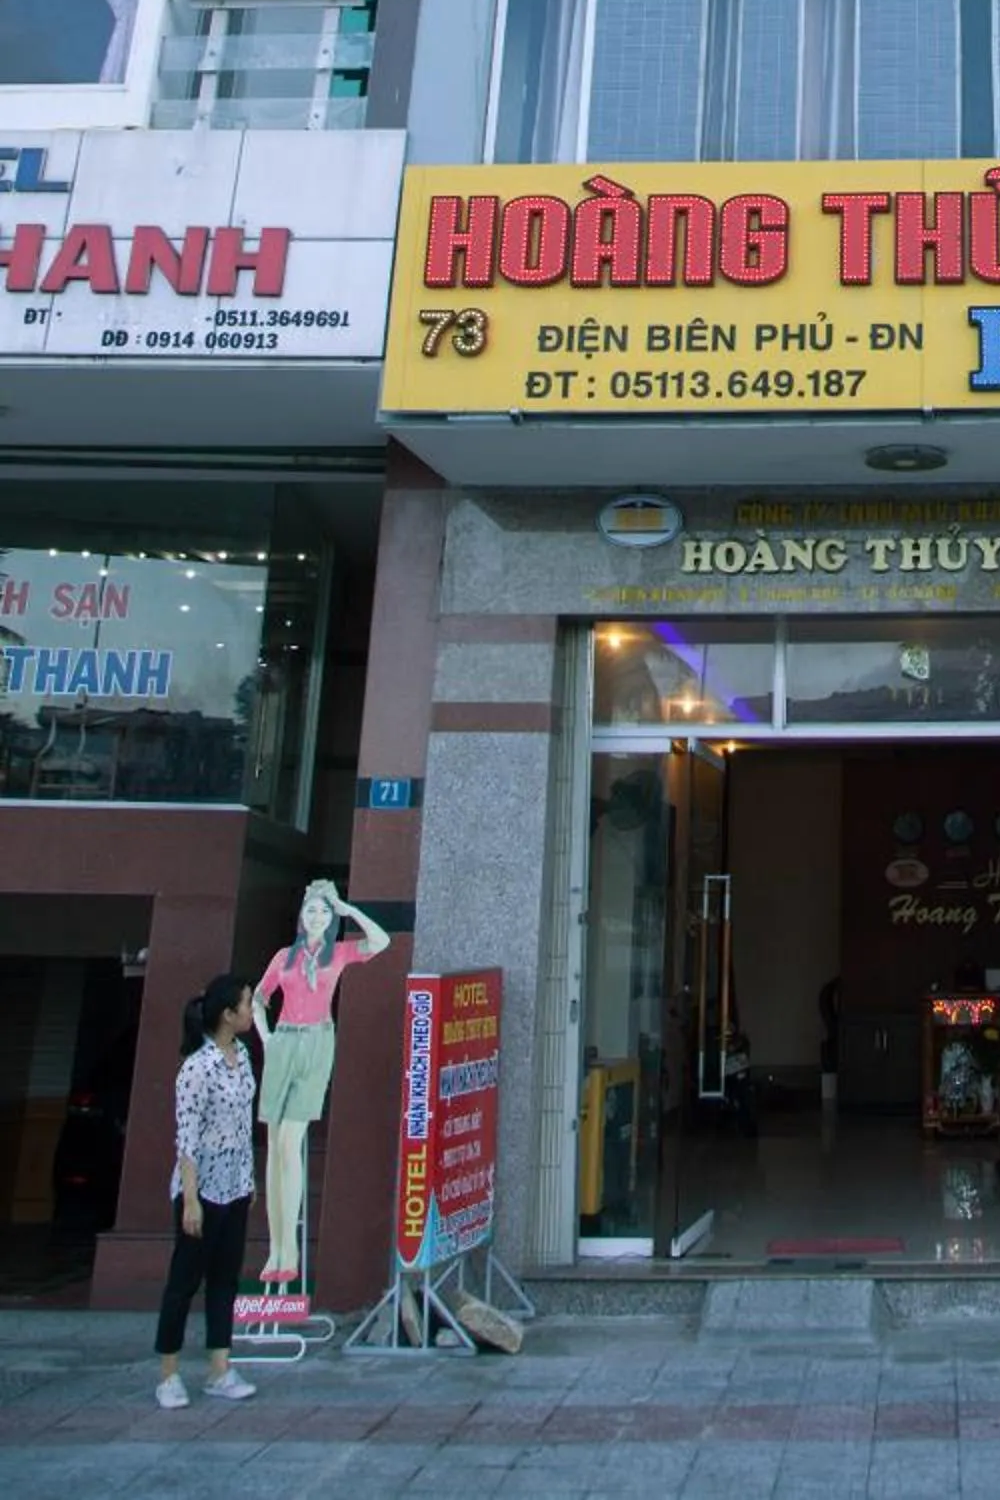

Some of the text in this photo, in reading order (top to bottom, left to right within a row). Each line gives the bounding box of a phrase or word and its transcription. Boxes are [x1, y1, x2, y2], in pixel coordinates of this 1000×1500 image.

[424, 175, 790, 288] HOÀNG
[145, 331, 195, 349] 0914
[205, 331, 279, 350] 060913
[418, 307, 490, 358] 73
[536, 316, 629, 360] ĐIỆN
[646, 316, 737, 353] BIÊN
[609, 369, 868, 399] 05113.649.187
[680, 529, 848, 574] HOÀNG
[50, 581, 132, 629] SẠN
[3, 645, 174, 698] THANH
[379, 780, 400, 803] 71
[888, 893, 978, 933] Hoang
[404, 1144, 428, 1237] HOTEL
